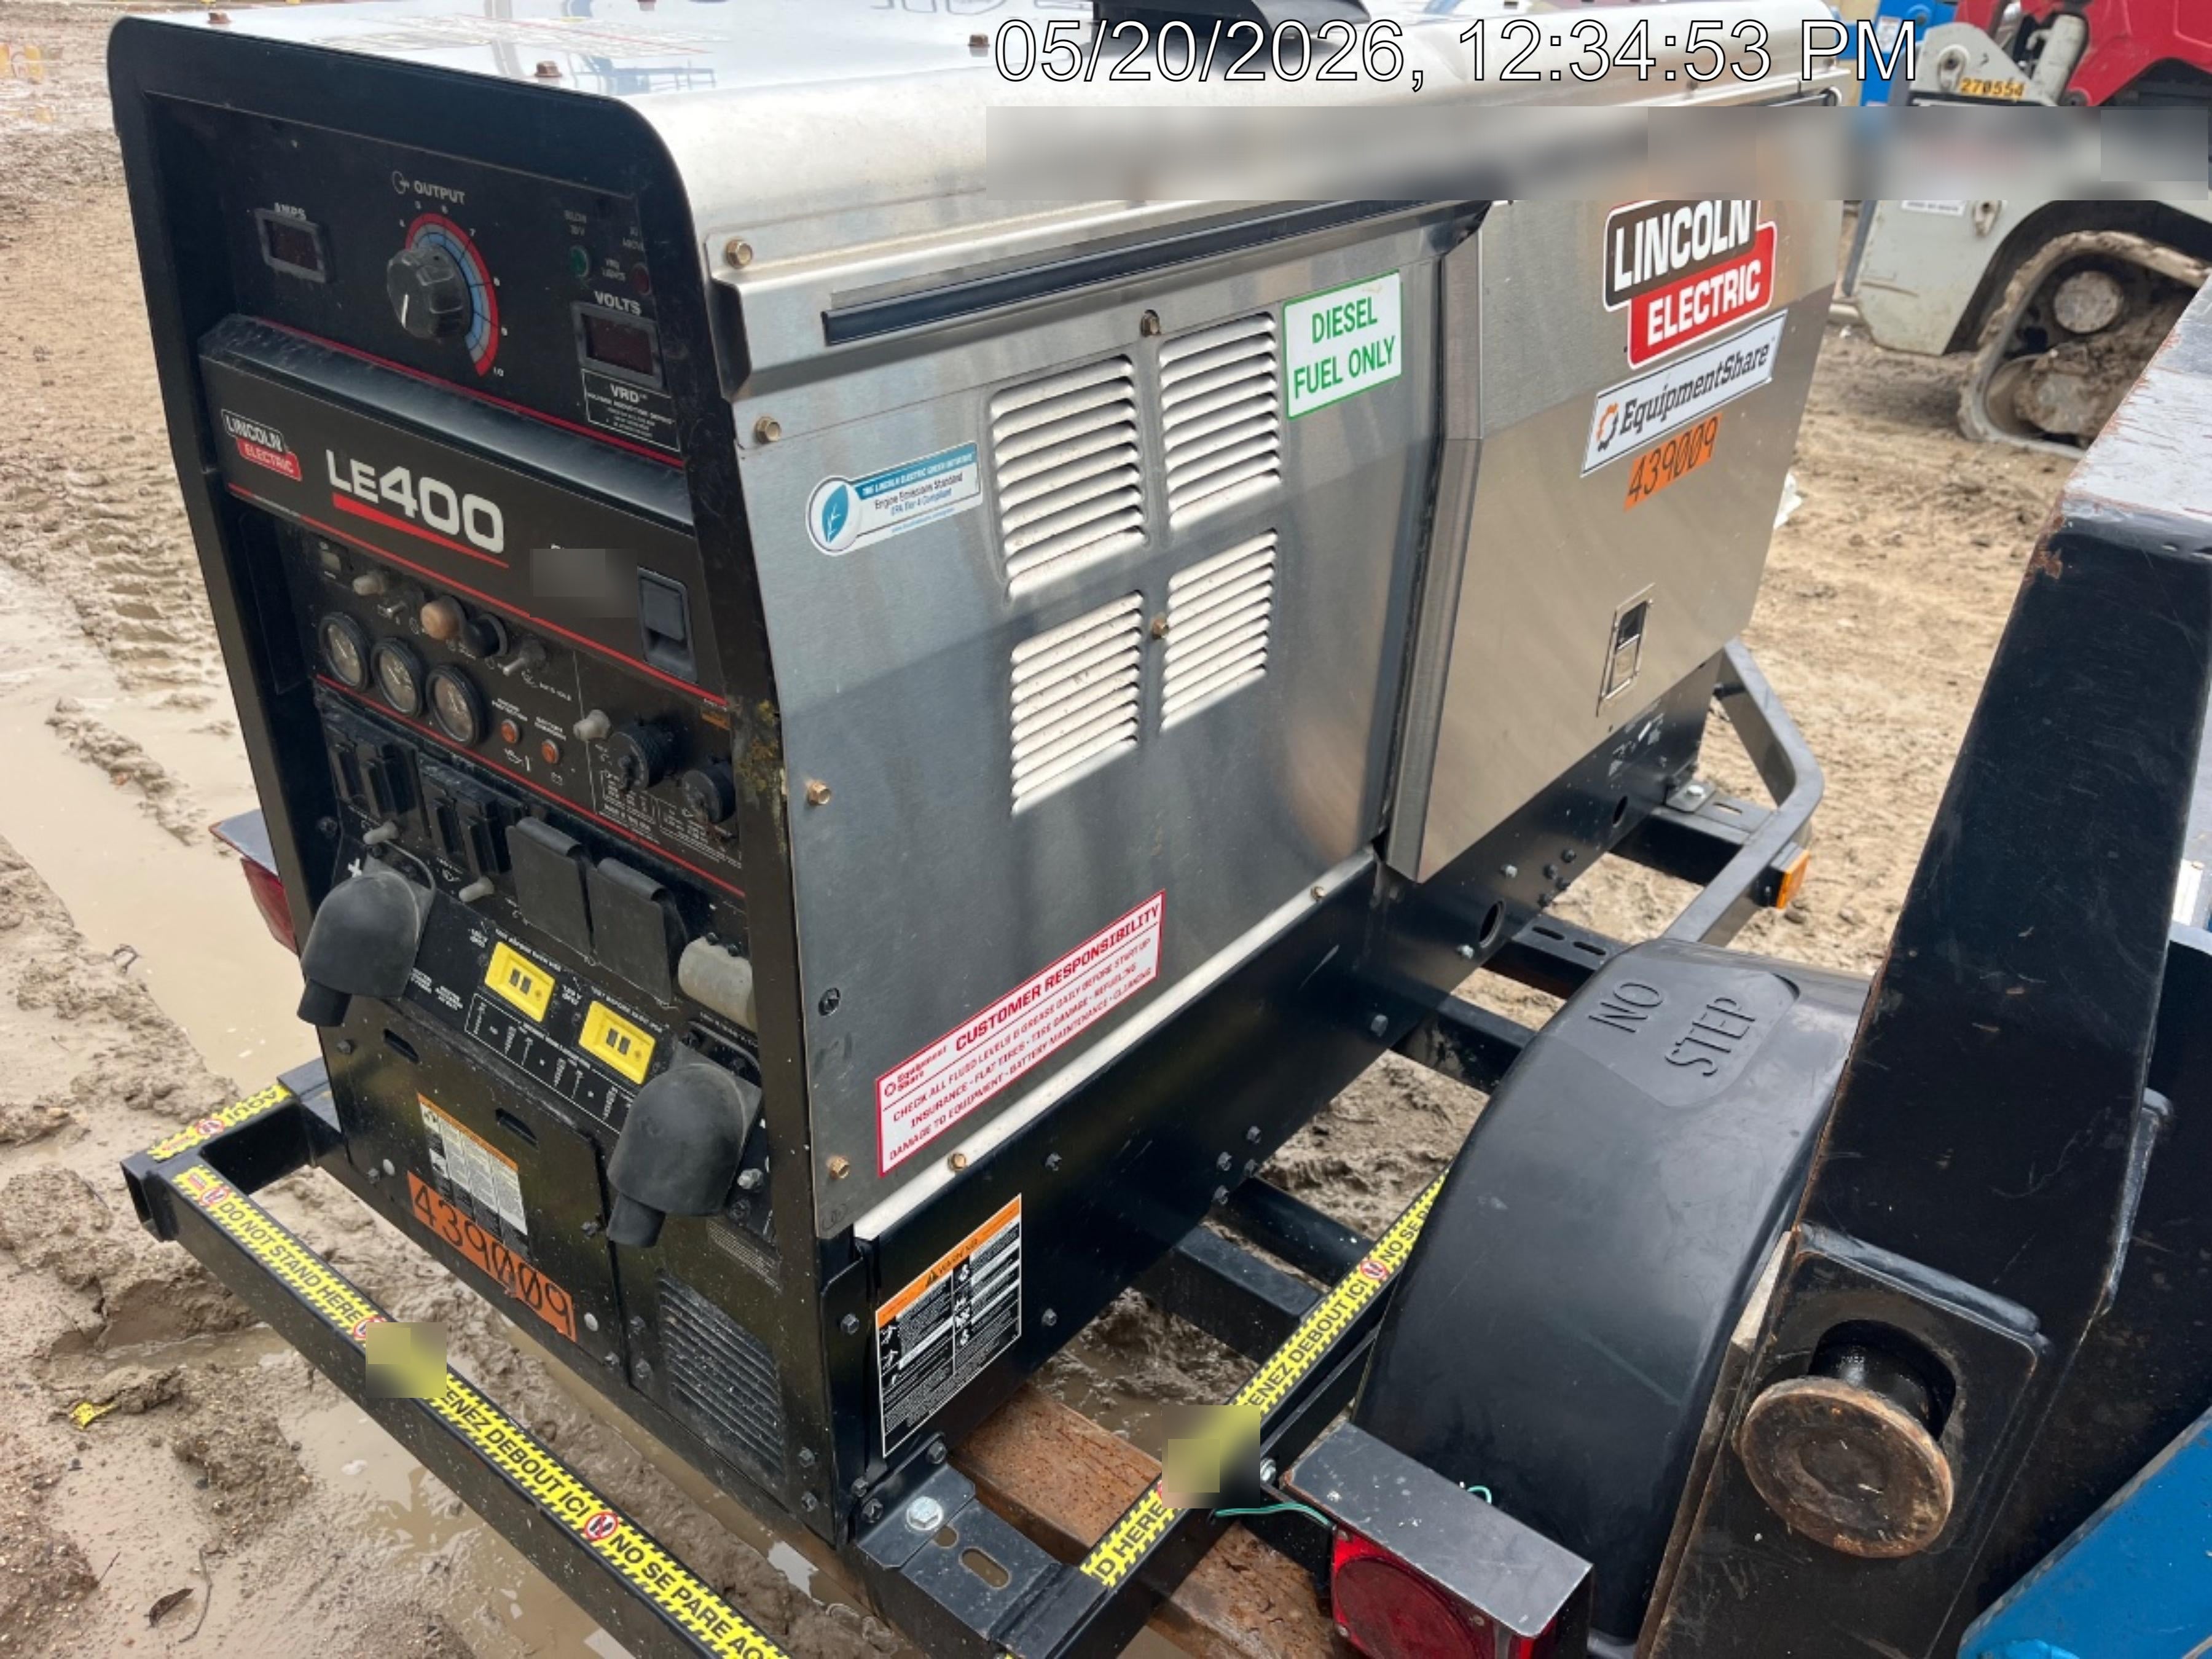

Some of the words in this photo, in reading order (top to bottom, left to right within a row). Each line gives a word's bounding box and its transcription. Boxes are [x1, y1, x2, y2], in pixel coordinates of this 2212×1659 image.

[274, 202, 306, 219] AMPS
[414, 180, 466, 205] OUTPUT
[1614, 200, 1751, 292] LINCOLN
[595, 291, 641, 316] VOLTS
[1312, 296, 1378, 344] DIESEL
[1647, 259, 1761, 346] ELECTRIC
[1294, 356, 1343, 399] FUEL
[1349, 335, 1395, 378] ONLY
[1620, 343, 1769, 435] EquipmentShare
[226, 415, 283, 452] LINCOLN
[244, 442, 294, 474] ELECTRIC
[1628, 415, 1719, 503] 439009
[326, 449, 504, 554] LE400
[934, 472, 963, 490] Standard
[955, 984, 1040, 1051] CUSTOMER
[1045, 903, 1159, 992] RESPONSIBILITY
[1588, 982, 1663, 1033] NO
[893, 1094, 928, 1122] CHECK
[929, 1080, 946, 1098] ALL
[978, 1035, 1011, 1064] LEVELS
[1021, 1004, 1055, 1033] GREASE
[1056, 987, 1081, 1010] DAILY
[1081, 967, 1112, 992] BEFORE
[1115, 949, 1138, 968] START
[1139, 938, 1151, 950] UP
[897, 1045, 947, 1082] Equipment
[911, 1081, 968, 1129] INSURANCE
[975, 1061, 996, 1083] FLAT
[998, 1041, 1025, 1065] TIRES
[1053, 999, 1088, 1027] DAMAGE
[1094, 963, 1136, 997] REFUELING
[1664, 997, 1756, 1077] STEP
[890, 1124, 931, 1161] DAMAGE
[934, 1114, 946, 1127] TO
[948, 1073, 1003, 1118] EQUIPMENT
[1009, 1040, 1048, 1075] BATTERY
[1049, 998, 1107, 1044] MAINTENANCE
[219, 1201, 240, 1225] DO
[240, 1216, 273, 1254] NOT
[269, 1244, 322, 1289] STAND
[318, 1278, 361, 1324] HERE
[415, 1183, 573, 1338] 439009
[1378, 1240, 1404, 1263] NO
[1288, 1298, 1350, 1363] DEBOUT
[1344, 1277, 1370, 1303] ICI
[487, 1427, 563, 1494] DEBOUT
[559, 1492, 592, 1519] ICI
[1112, 1504, 1163, 1561] HERE
[608, 1533, 645, 1565] NO
[642, 1559, 677, 1591] SE
[670, 1585, 734, 1639] PARE
